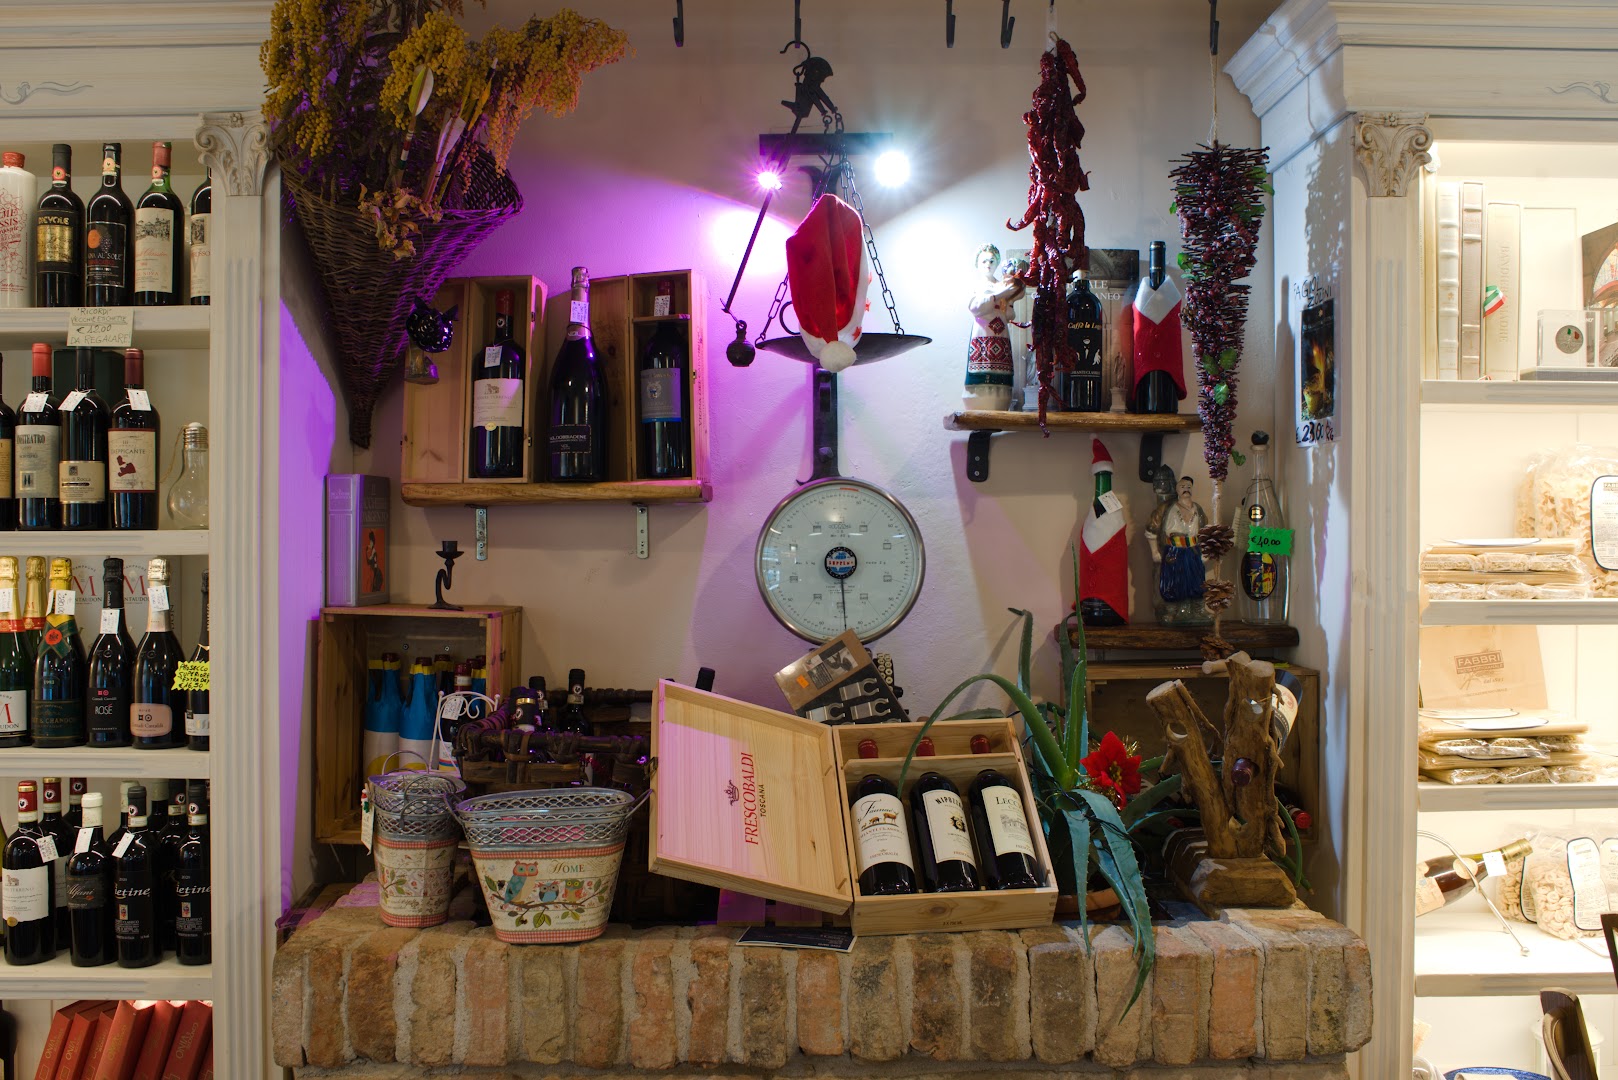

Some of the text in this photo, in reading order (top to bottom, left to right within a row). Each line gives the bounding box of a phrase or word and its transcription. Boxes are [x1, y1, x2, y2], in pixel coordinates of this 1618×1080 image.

[1250, 535, 1258, 544] €
[71, 575, 97, 597] M
[123, 575, 147, 596] M
[1457, 653, 1501, 667] FABBRI
[94, 703, 114, 715] ROSÉ
[740, 751, 759, 846] FRESCOBALDI
[758, 783, 767, 818] TOSCANA
[546, 859, 585, 875] HOME
[45, 1038, 56, 1059] VINO
[65, 1037, 76, 1061] VINO
[175, 1034, 189, 1060] VINO
